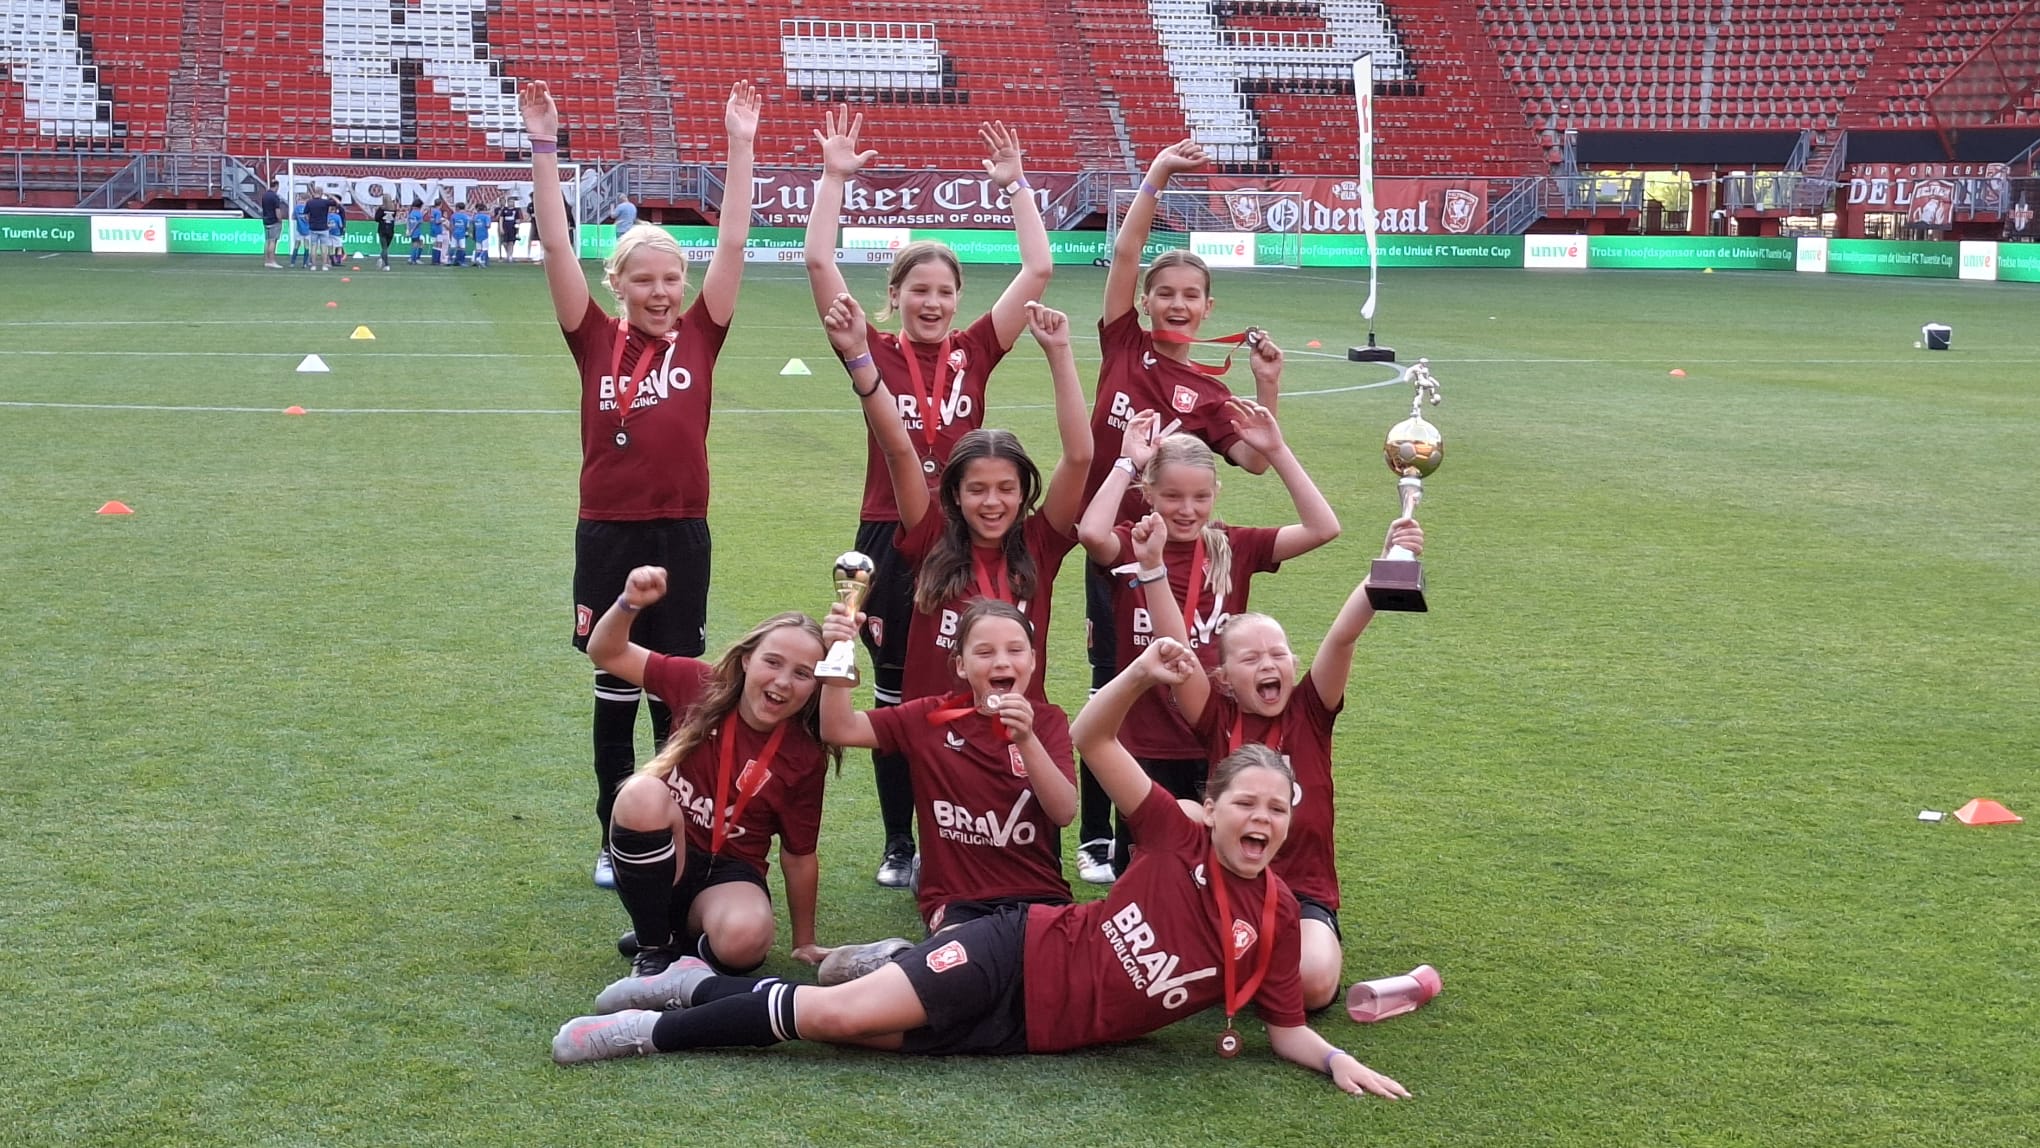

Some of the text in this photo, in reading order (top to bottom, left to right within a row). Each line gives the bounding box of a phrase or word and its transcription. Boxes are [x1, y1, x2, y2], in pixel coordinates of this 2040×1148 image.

[1848, 179, 1889, 205] DE
[858, 214, 944, 225] AANPASSEN
[949, 214, 969, 223] OF
[2, 227, 75, 241] Twente Cup
[98, 225, 155, 241] univé
[1435, 246, 1449, 256] FC
[1450, 246, 1489, 256] Twente
[1491, 246, 1511, 259] Cup
[1531, 242, 1578, 258] univé
[1717, 248, 1730, 258] de
[933, 788, 1036, 847] BRAVO
[1101, 919, 1148, 990] BEVEILIGING
[1112, 902, 1217, 1010] BRAVO
